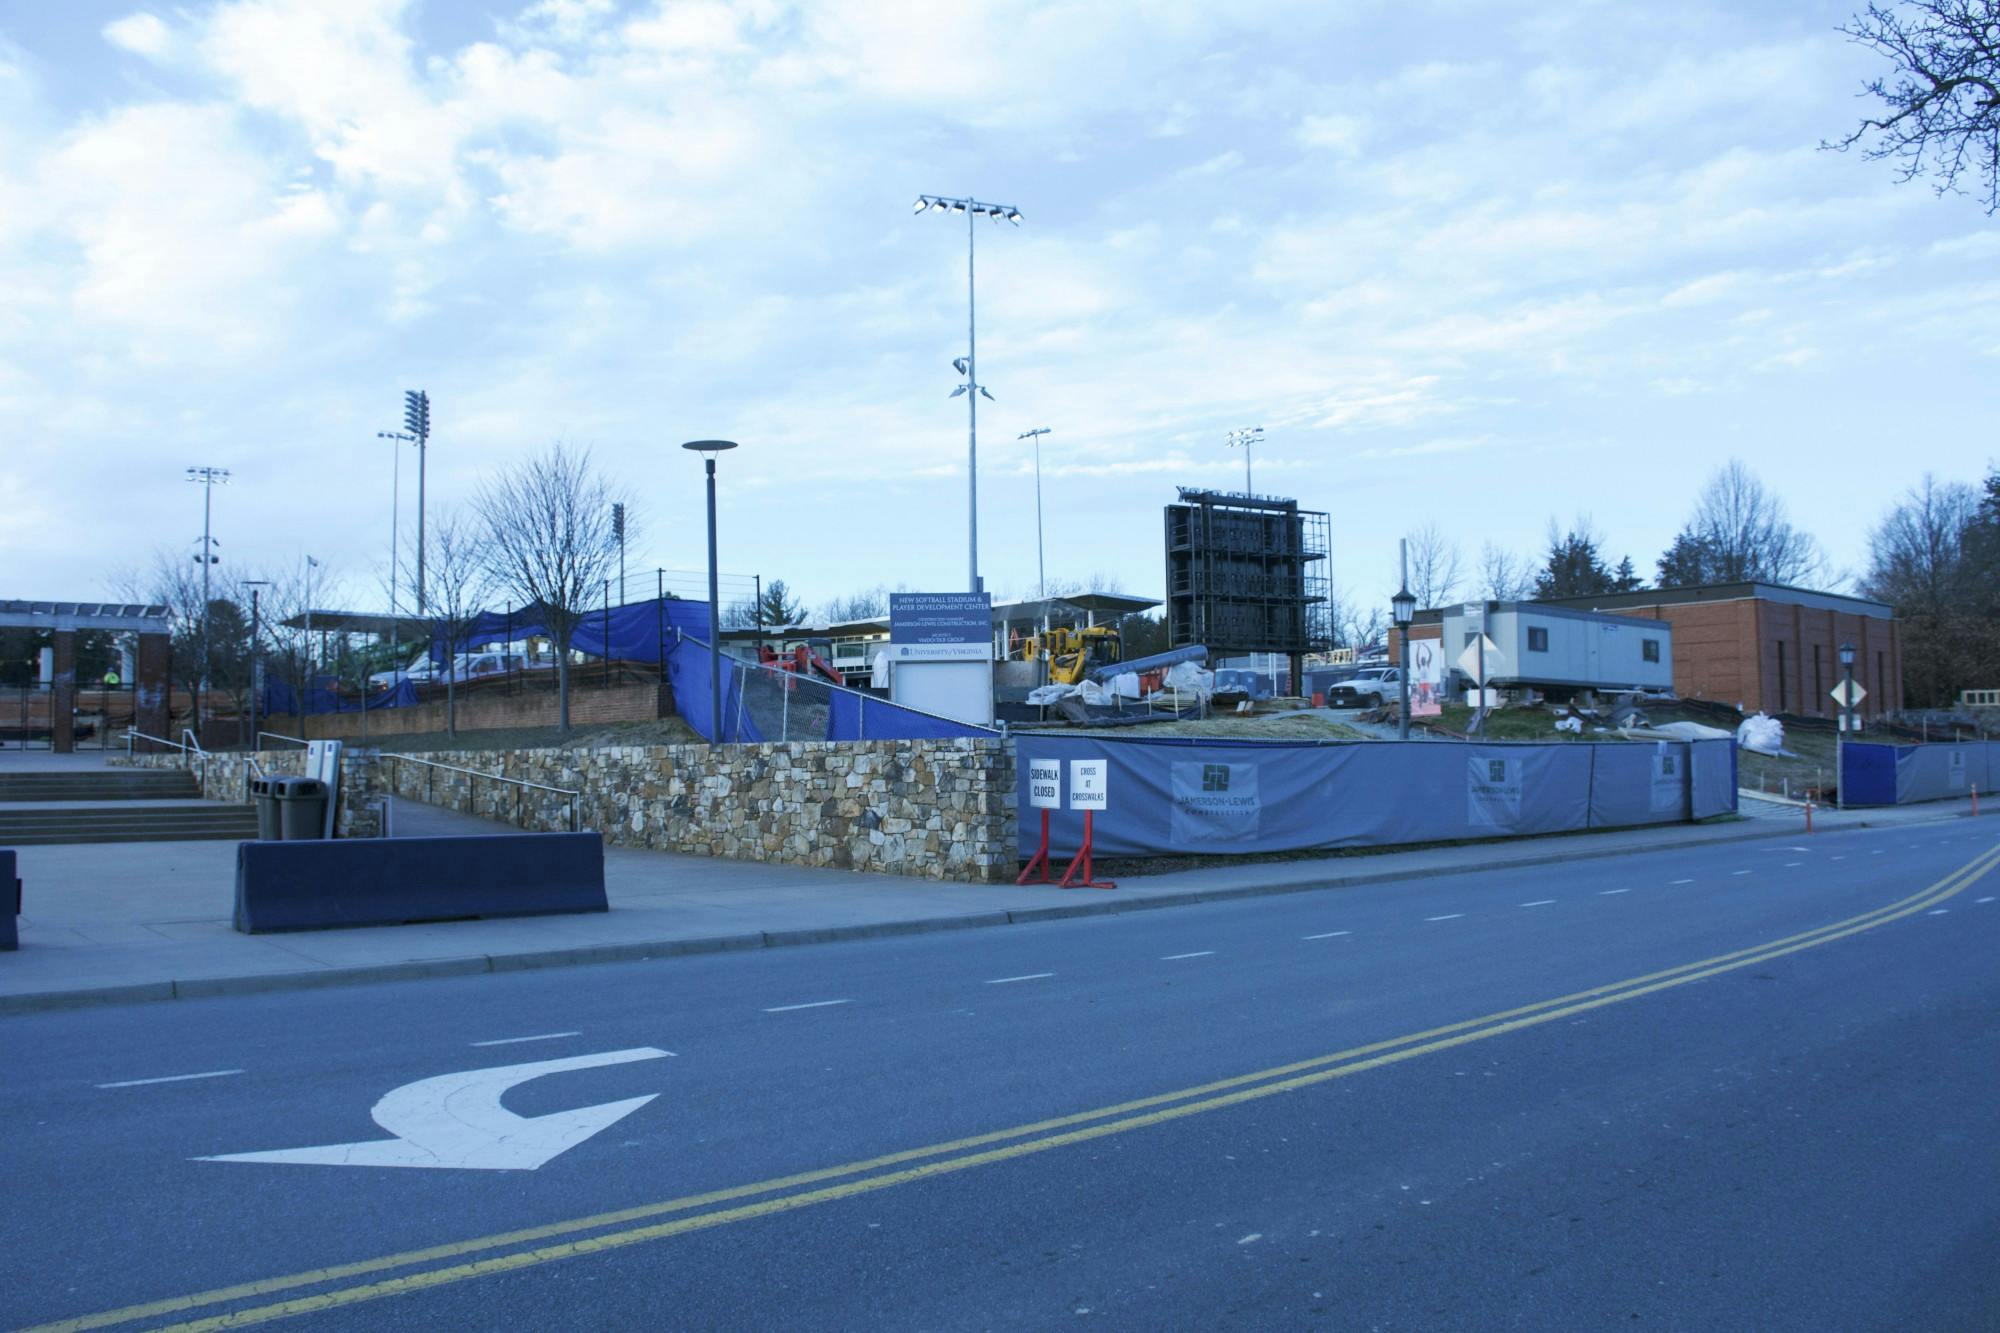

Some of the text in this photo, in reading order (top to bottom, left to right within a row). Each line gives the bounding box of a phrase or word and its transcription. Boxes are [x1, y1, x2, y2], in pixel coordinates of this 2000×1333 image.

[916, 603, 963, 611] DEVELOPMENT
[1030, 768, 1059, 780] SIDEWALK
[1080, 767, 1096, 776] CROSS
[1085, 779, 1091, 788] AT
[1033, 785, 1055, 798] CLOSED
[1072, 792, 1104, 801] CROSSWALKS
